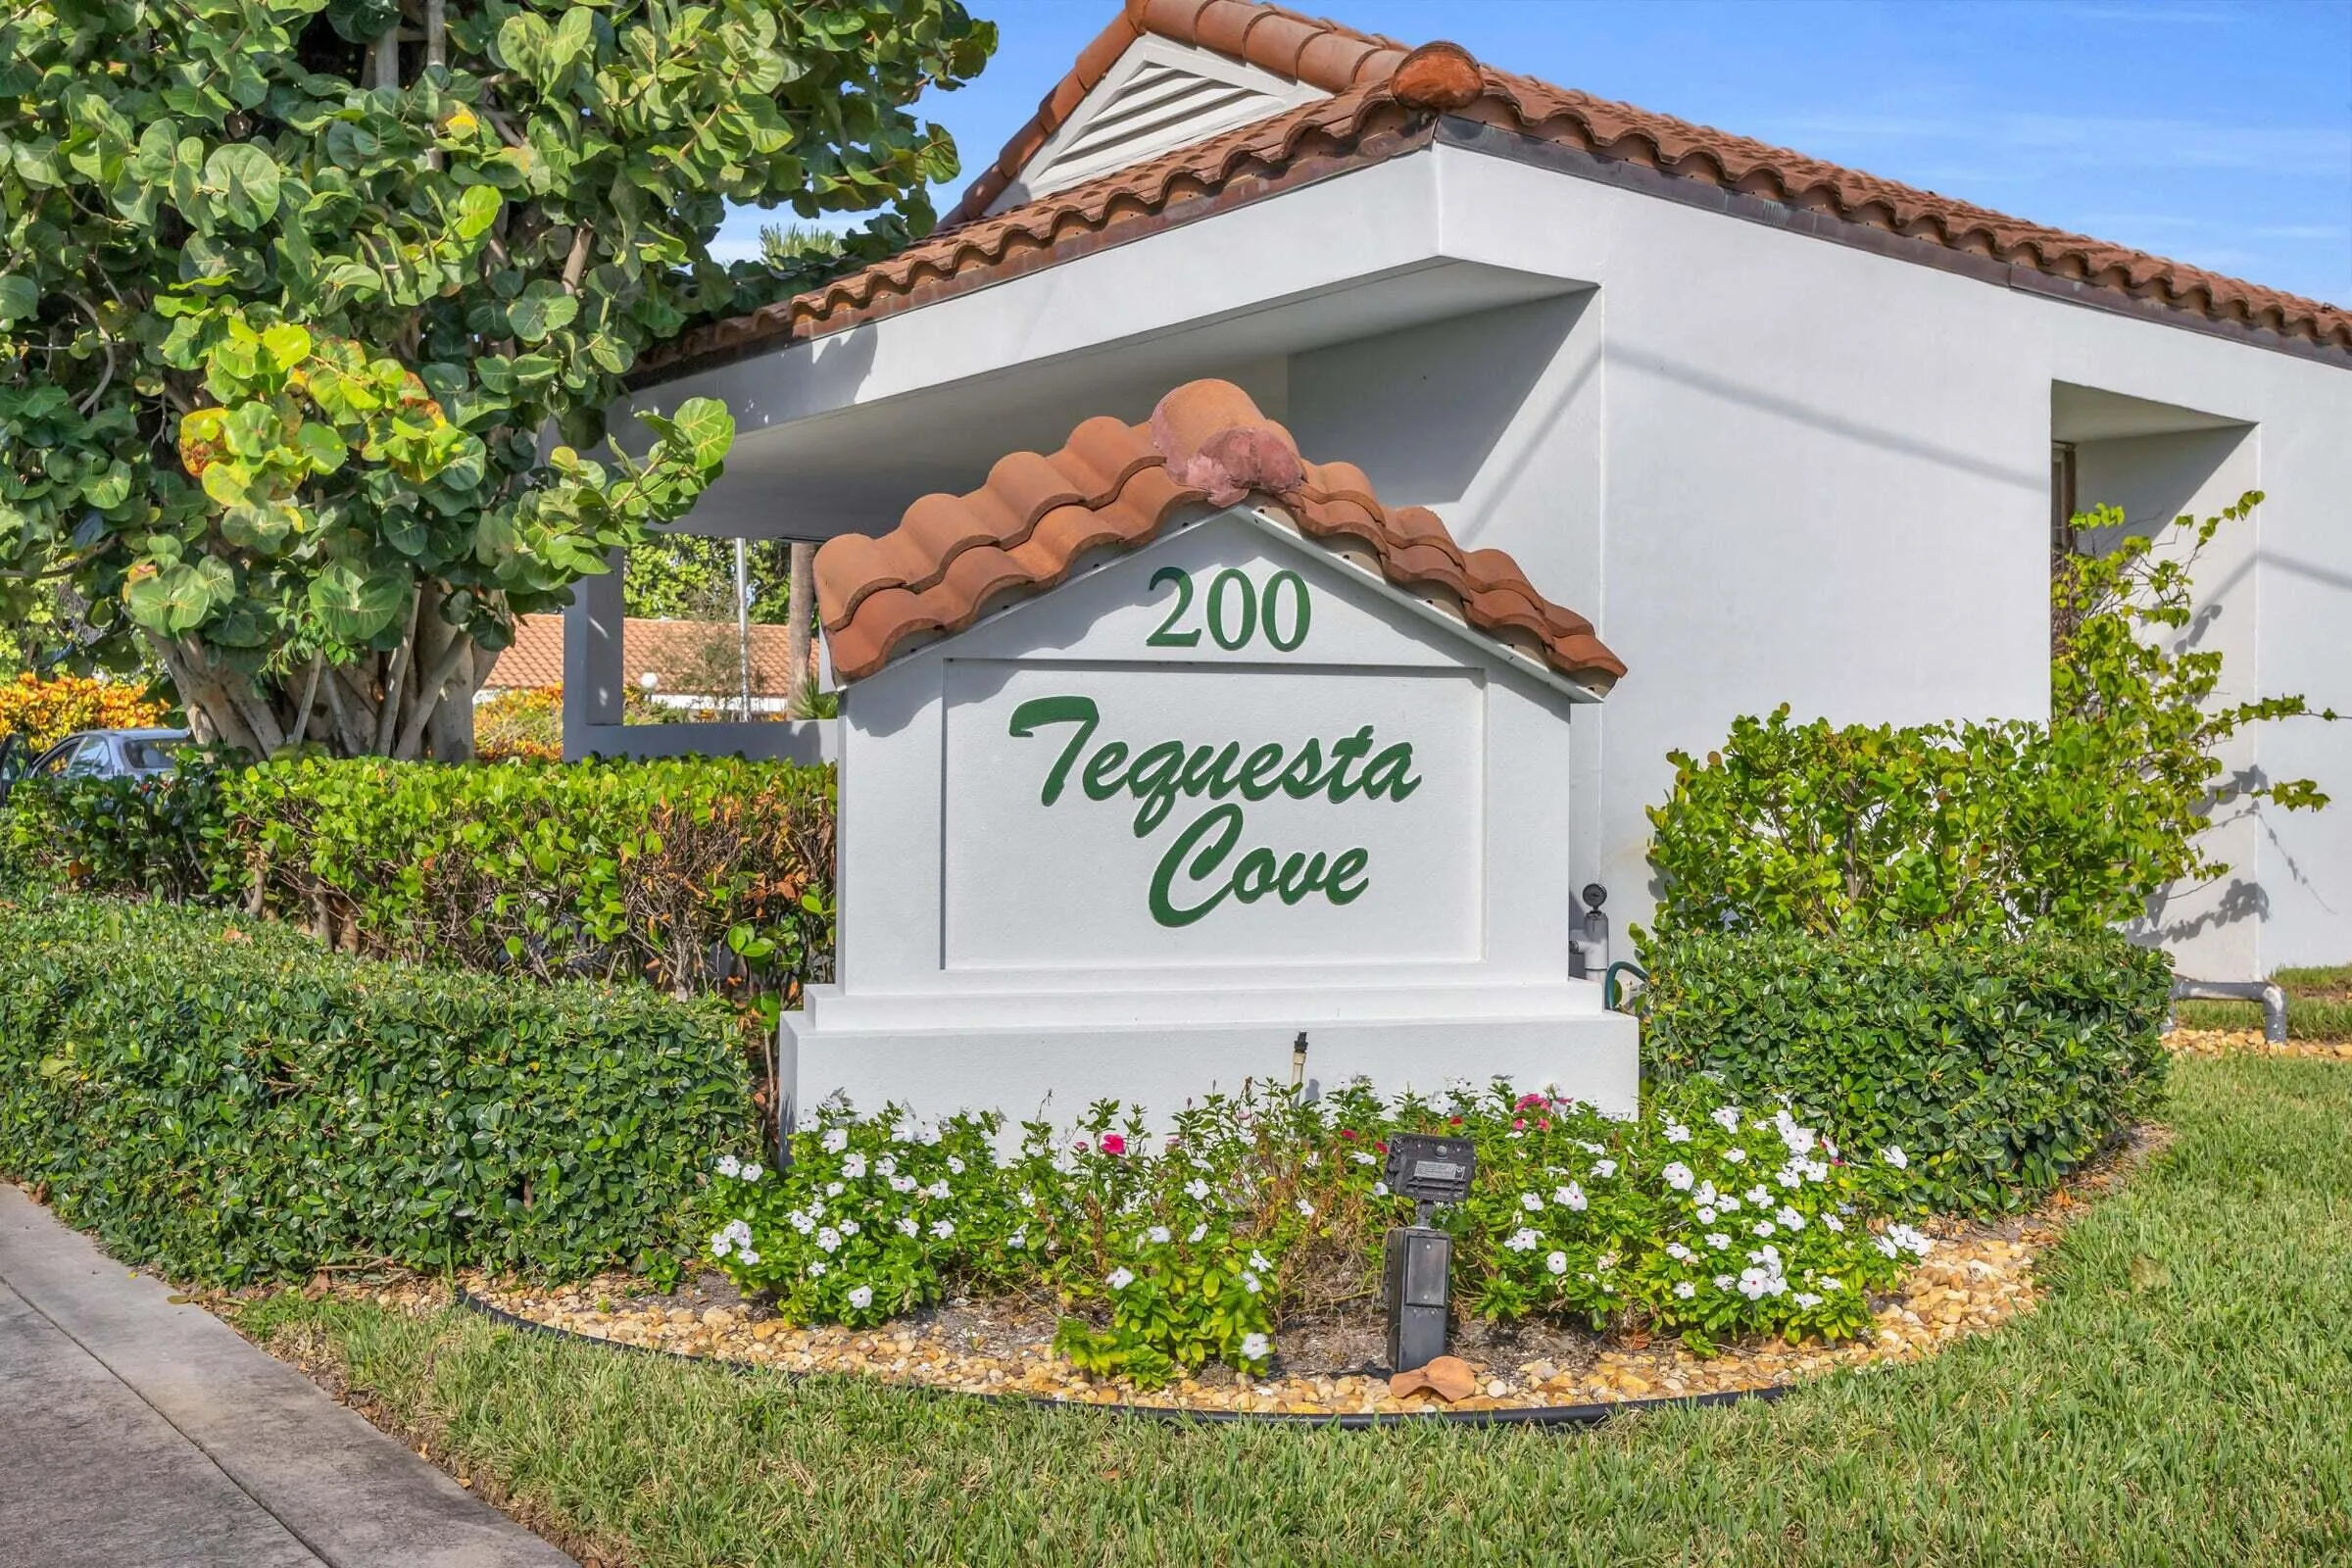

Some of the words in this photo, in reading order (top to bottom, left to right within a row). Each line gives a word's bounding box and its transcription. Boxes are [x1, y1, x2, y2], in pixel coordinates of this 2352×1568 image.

[1147, 567, 1311, 651] 200
[1009, 696, 1421, 838] Tequesta
[1149, 804, 1369, 927] Cove
